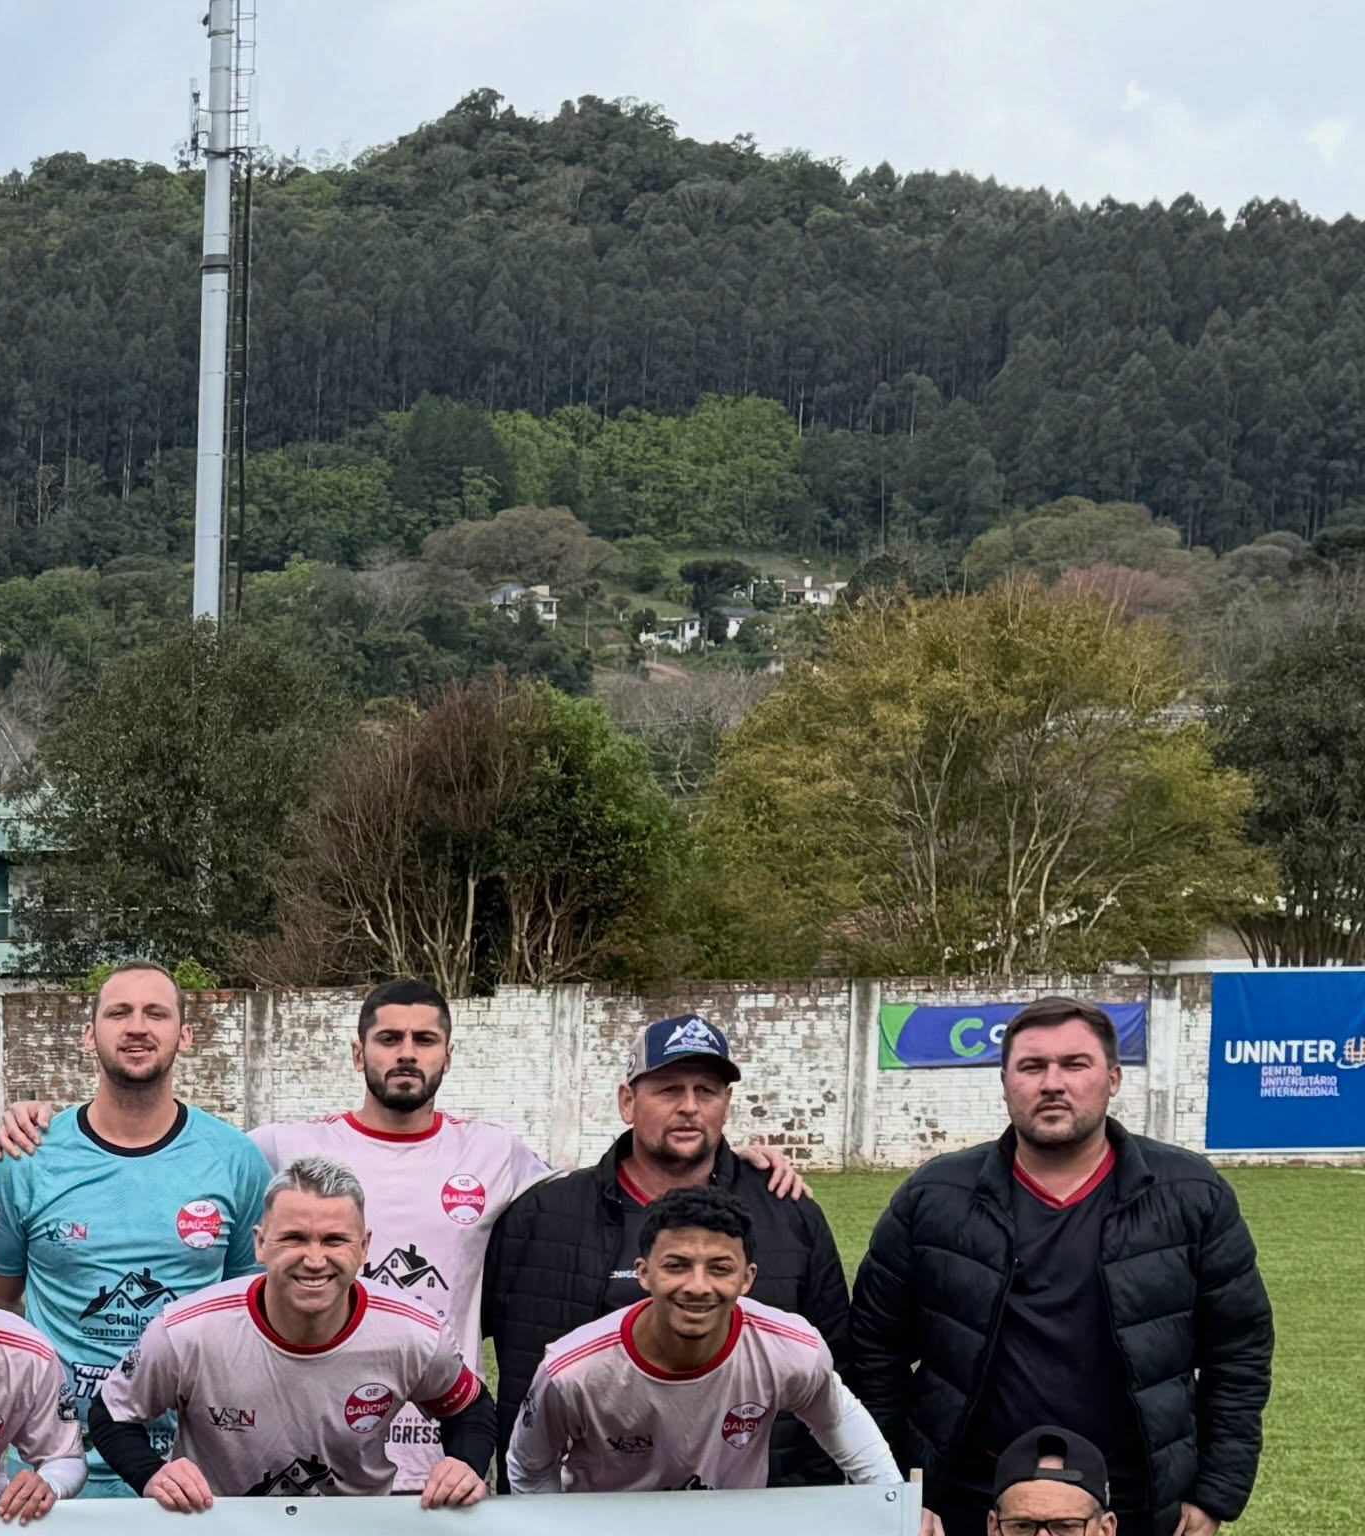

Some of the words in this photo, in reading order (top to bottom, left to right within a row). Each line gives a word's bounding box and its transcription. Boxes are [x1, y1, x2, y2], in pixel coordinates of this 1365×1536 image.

[1225, 1040, 1336, 1063] UNINTER
[1261, 1066, 1302, 1076] CENTRO
[1261, 1073, 1337, 1087] UNIVERSITÁRIO
[1260, 1086, 1340, 1097] INTERNACIONAL
[365, 1388, 379, 1397] GE
[208, 1406, 256, 1426] VSN
